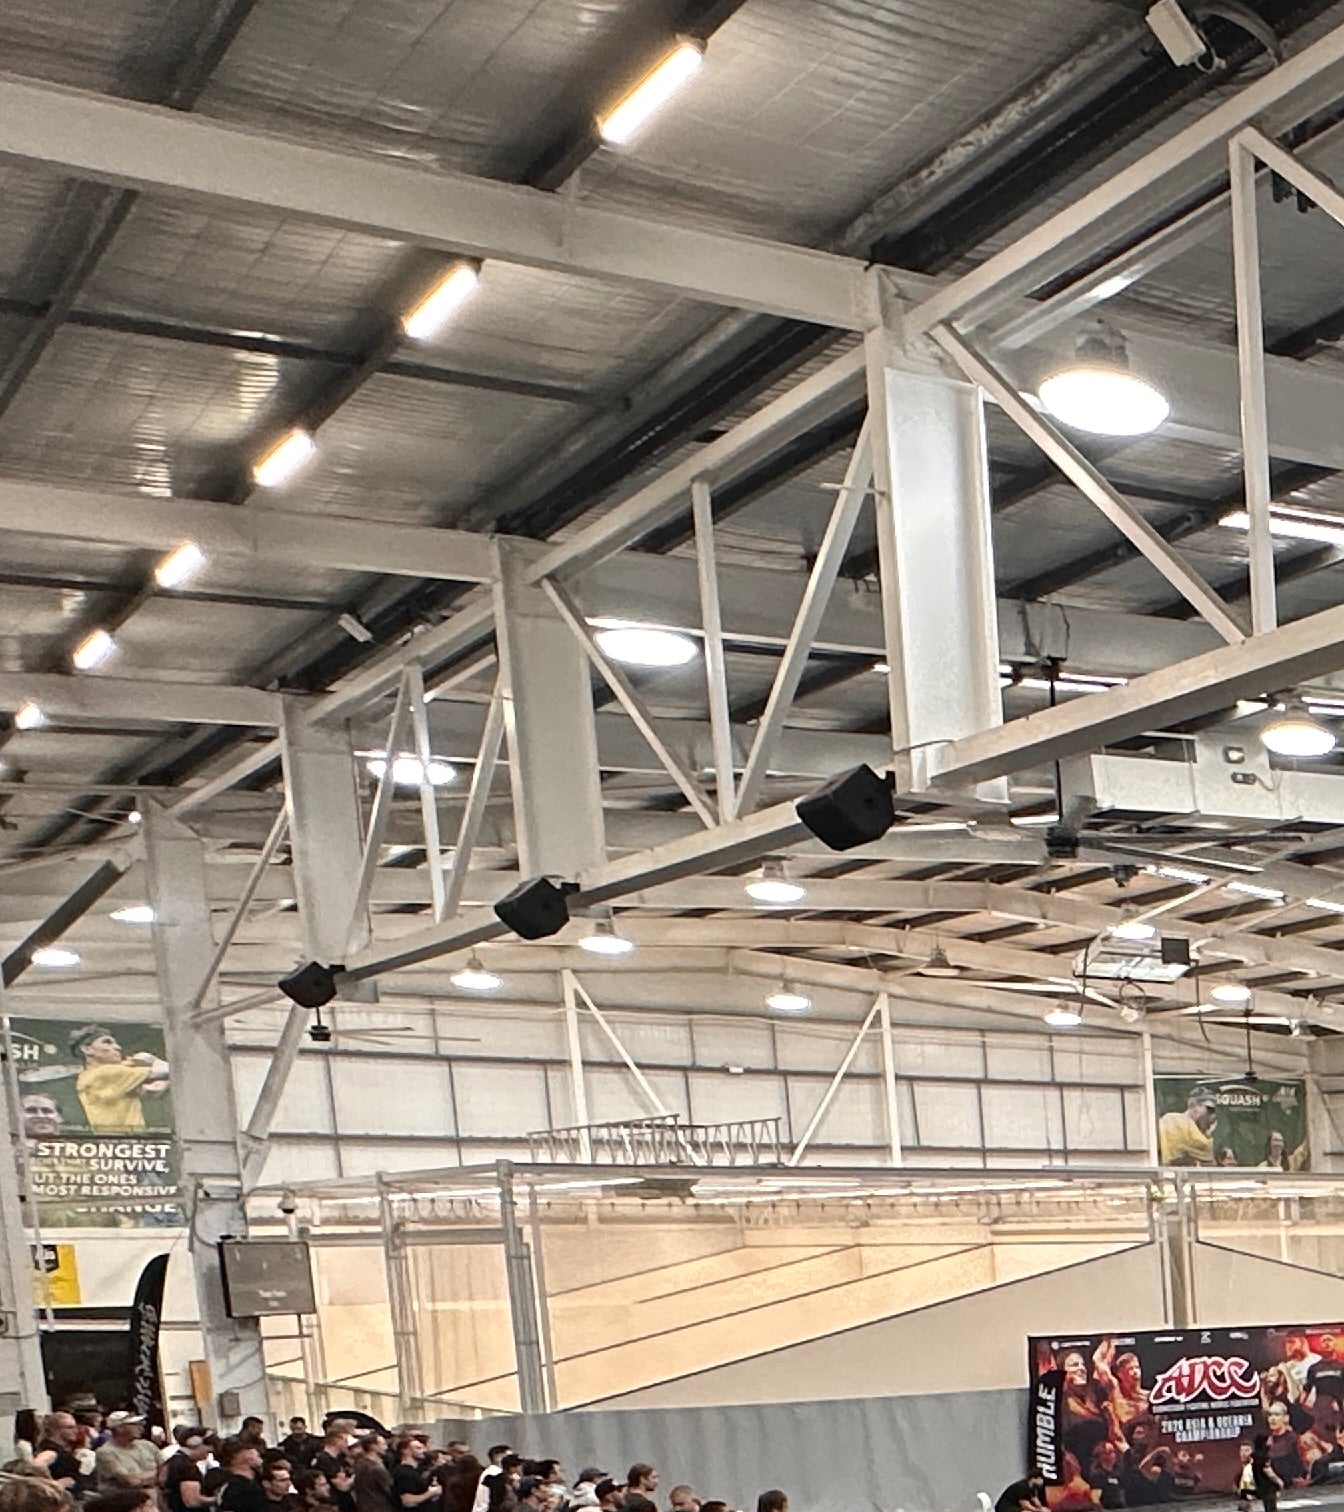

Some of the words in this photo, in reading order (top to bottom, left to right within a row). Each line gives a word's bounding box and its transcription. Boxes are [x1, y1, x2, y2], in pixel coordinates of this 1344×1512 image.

[37, 1142, 171, 1158] STRONGEST
[90, 1159, 169, 1173] SURVIVE,
[61, 1173, 91, 1184] THE
[95, 1174, 137, 1184] ONES
